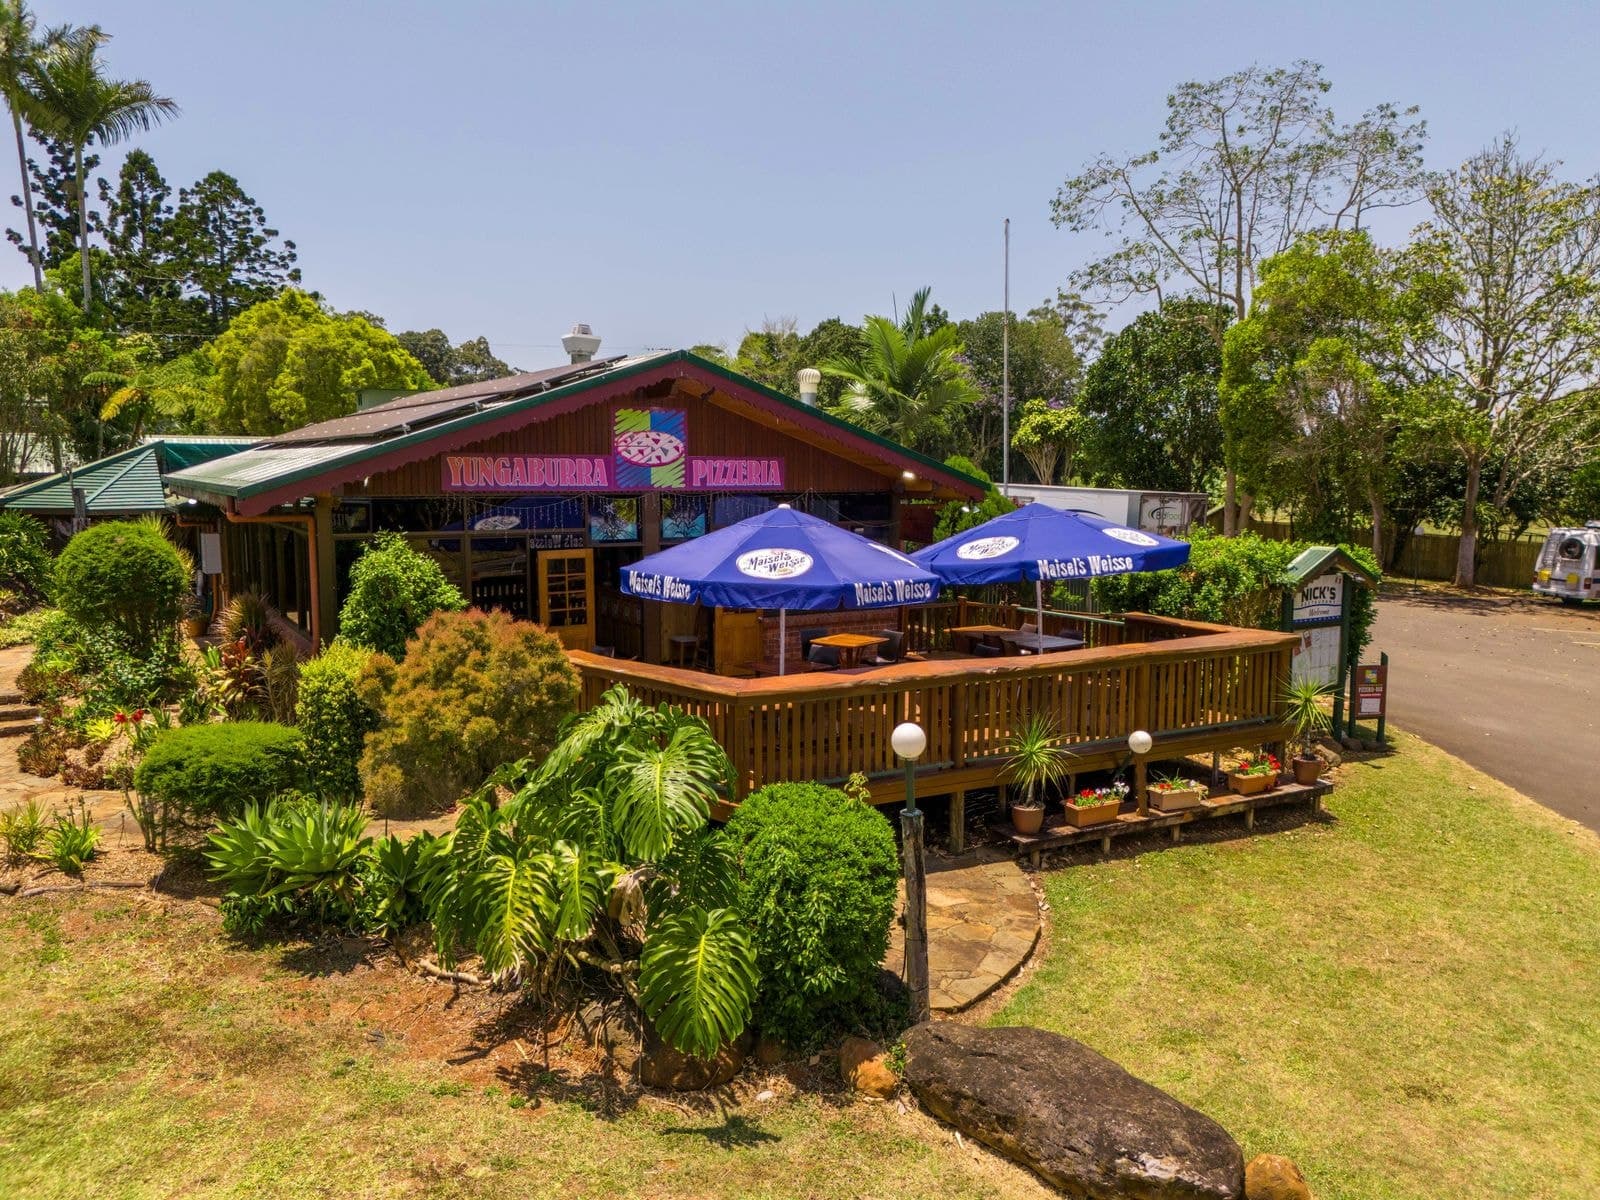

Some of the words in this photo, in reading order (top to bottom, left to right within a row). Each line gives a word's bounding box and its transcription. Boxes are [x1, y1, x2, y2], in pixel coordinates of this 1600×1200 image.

[446, 456, 608, 487] YUNGABURRA
[692, 458, 781, 487] PIZZERIA
[750, 552, 792, 570] Maisel's
[768, 556, 806, 572] Weisse
[1037, 557, 1087, 579] Maisel's
[1087, 555, 1133, 575] Weisse
[629, 570, 661, 594] Maisel's
[663, 575, 691, 599] Weisse
[854, 582, 893, 606] Maisel's
[894, 579, 931, 602] Weisse
[1302, 586, 1336, 602] NICK'S
